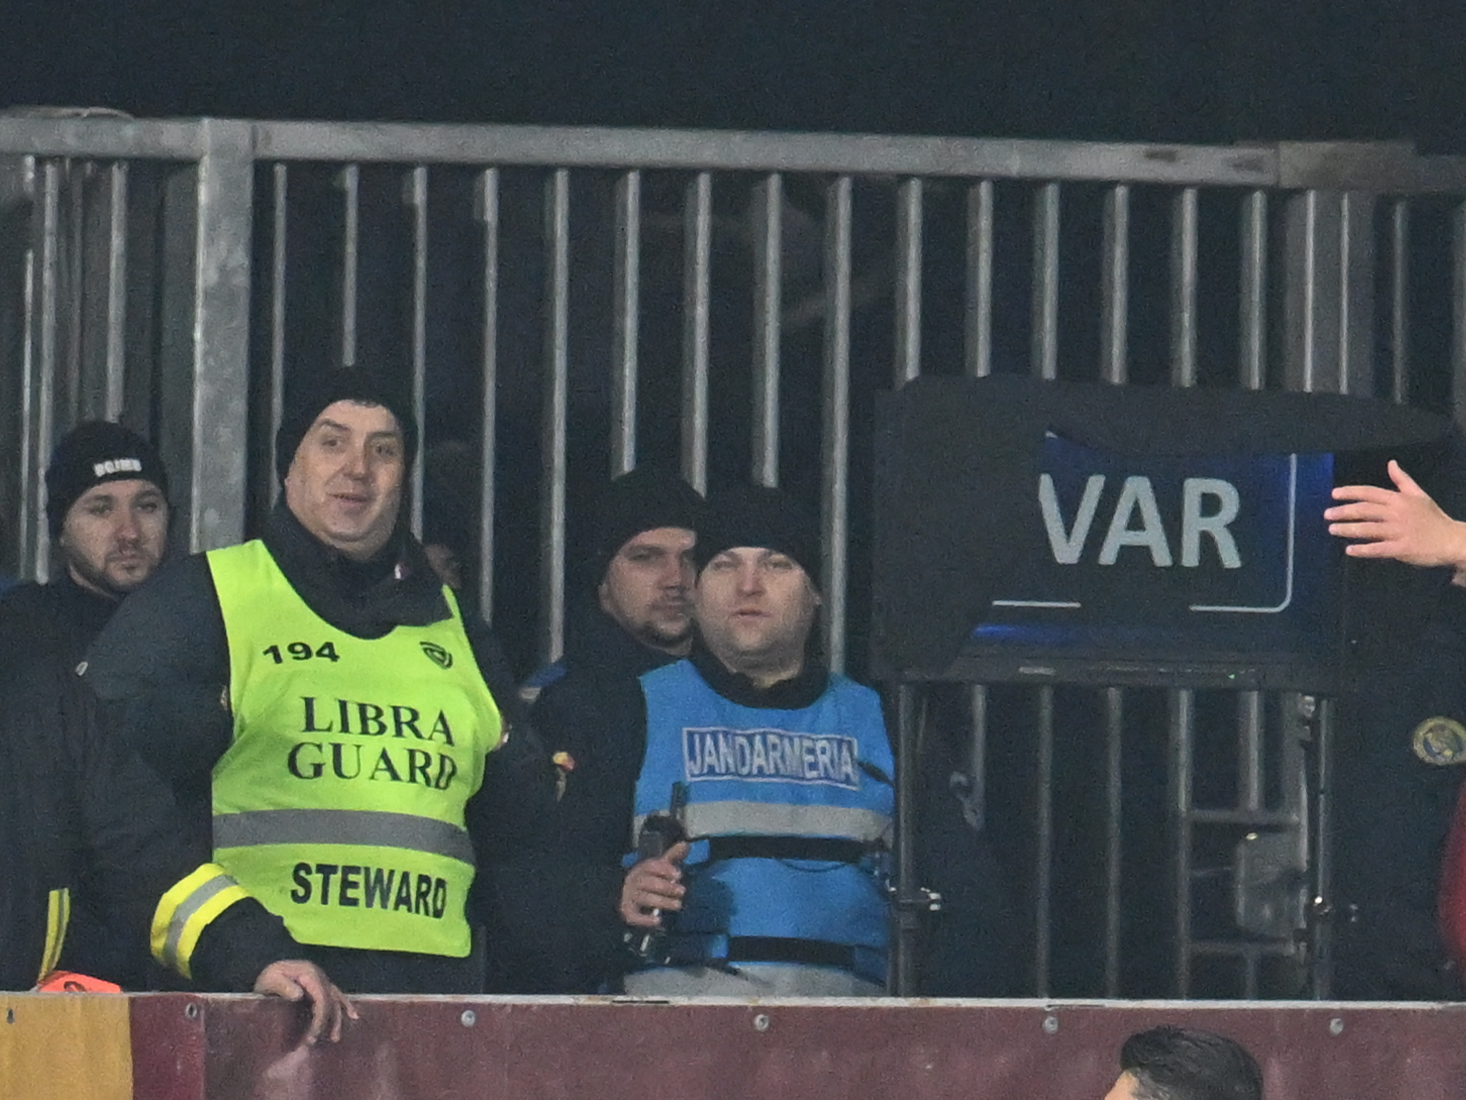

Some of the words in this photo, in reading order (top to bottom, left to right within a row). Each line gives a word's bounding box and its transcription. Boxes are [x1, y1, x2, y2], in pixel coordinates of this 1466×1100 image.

[1039, 474, 1242, 569] VAR
[263, 641, 341, 664] 194
[301, 697, 455, 747] LIBRA
[287, 741, 458, 790] GUARD
[688, 734, 857, 782] JANDARMERIA
[290, 862, 447, 919] STEWARD
